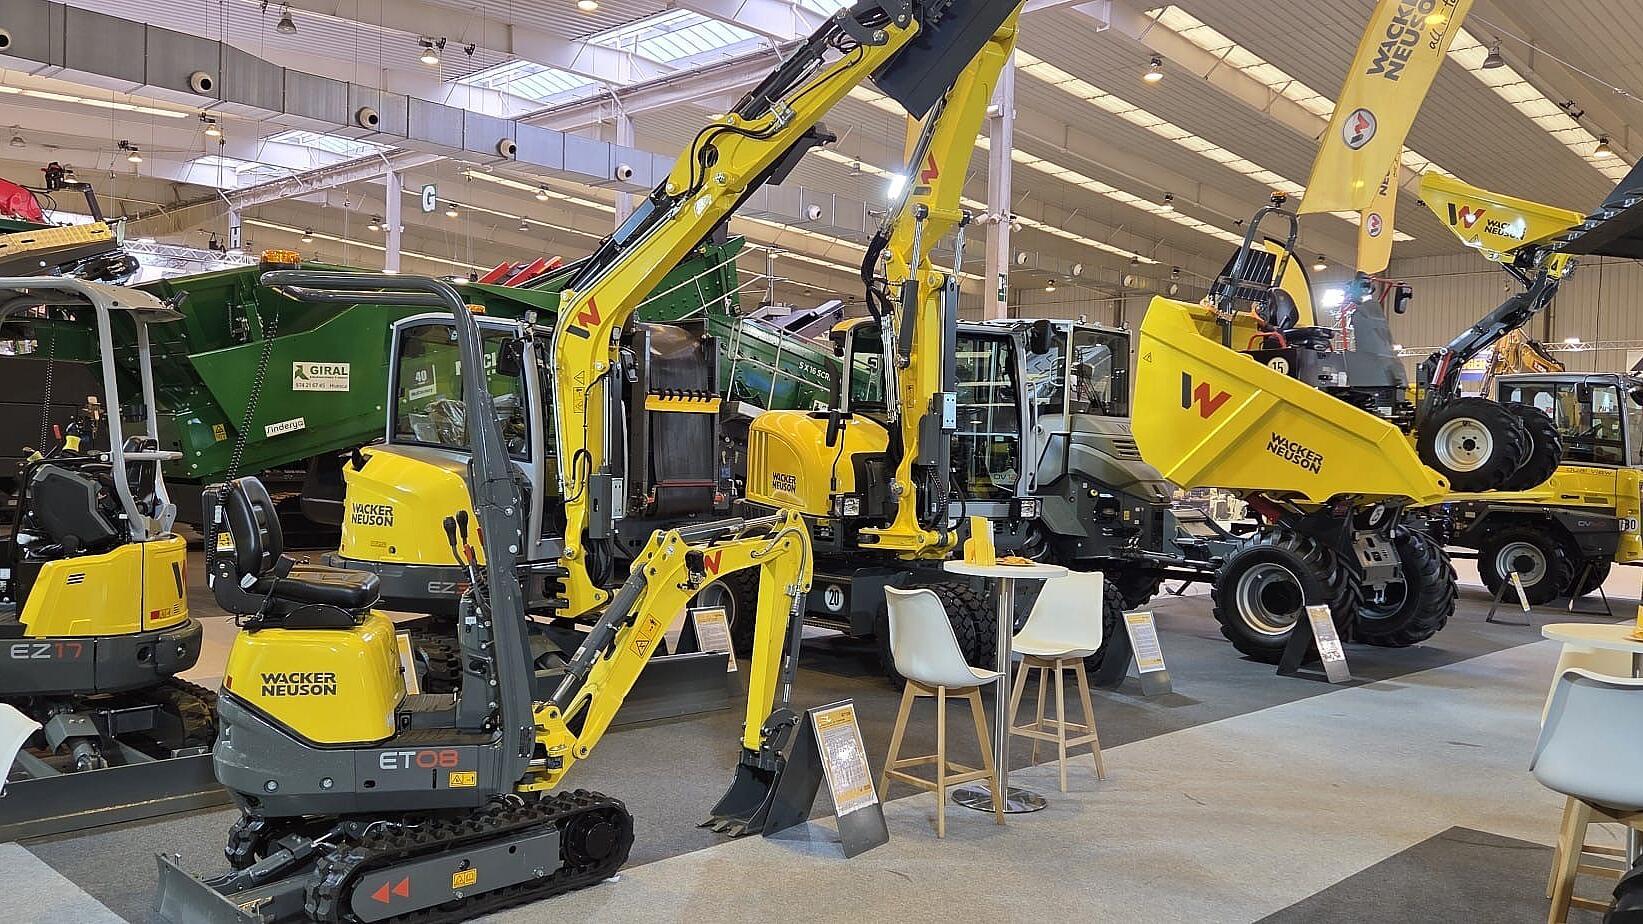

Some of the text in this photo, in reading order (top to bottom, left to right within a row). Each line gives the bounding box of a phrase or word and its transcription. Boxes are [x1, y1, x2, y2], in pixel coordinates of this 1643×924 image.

[422, 185, 436, 212] G
[309, 366, 348, 376] GIRAL
[1272, 361, 1284, 374] 15
[1271, 431, 1324, 466] WACKER
[1266, 442, 1321, 475] NEUSON
[772, 471, 796, 485] WACKER
[772, 480, 796, 494] NEUSON
[352, 502, 394, 517] WACKER
[351, 513, 394, 527] NEUSON
[829, 589, 839, 606] 20
[10, 642, 83, 660] EZ17
[260, 672, 337, 684] WACKER
[261, 684, 337, 697] NEUSON
[379, 749, 459, 770] ET08
